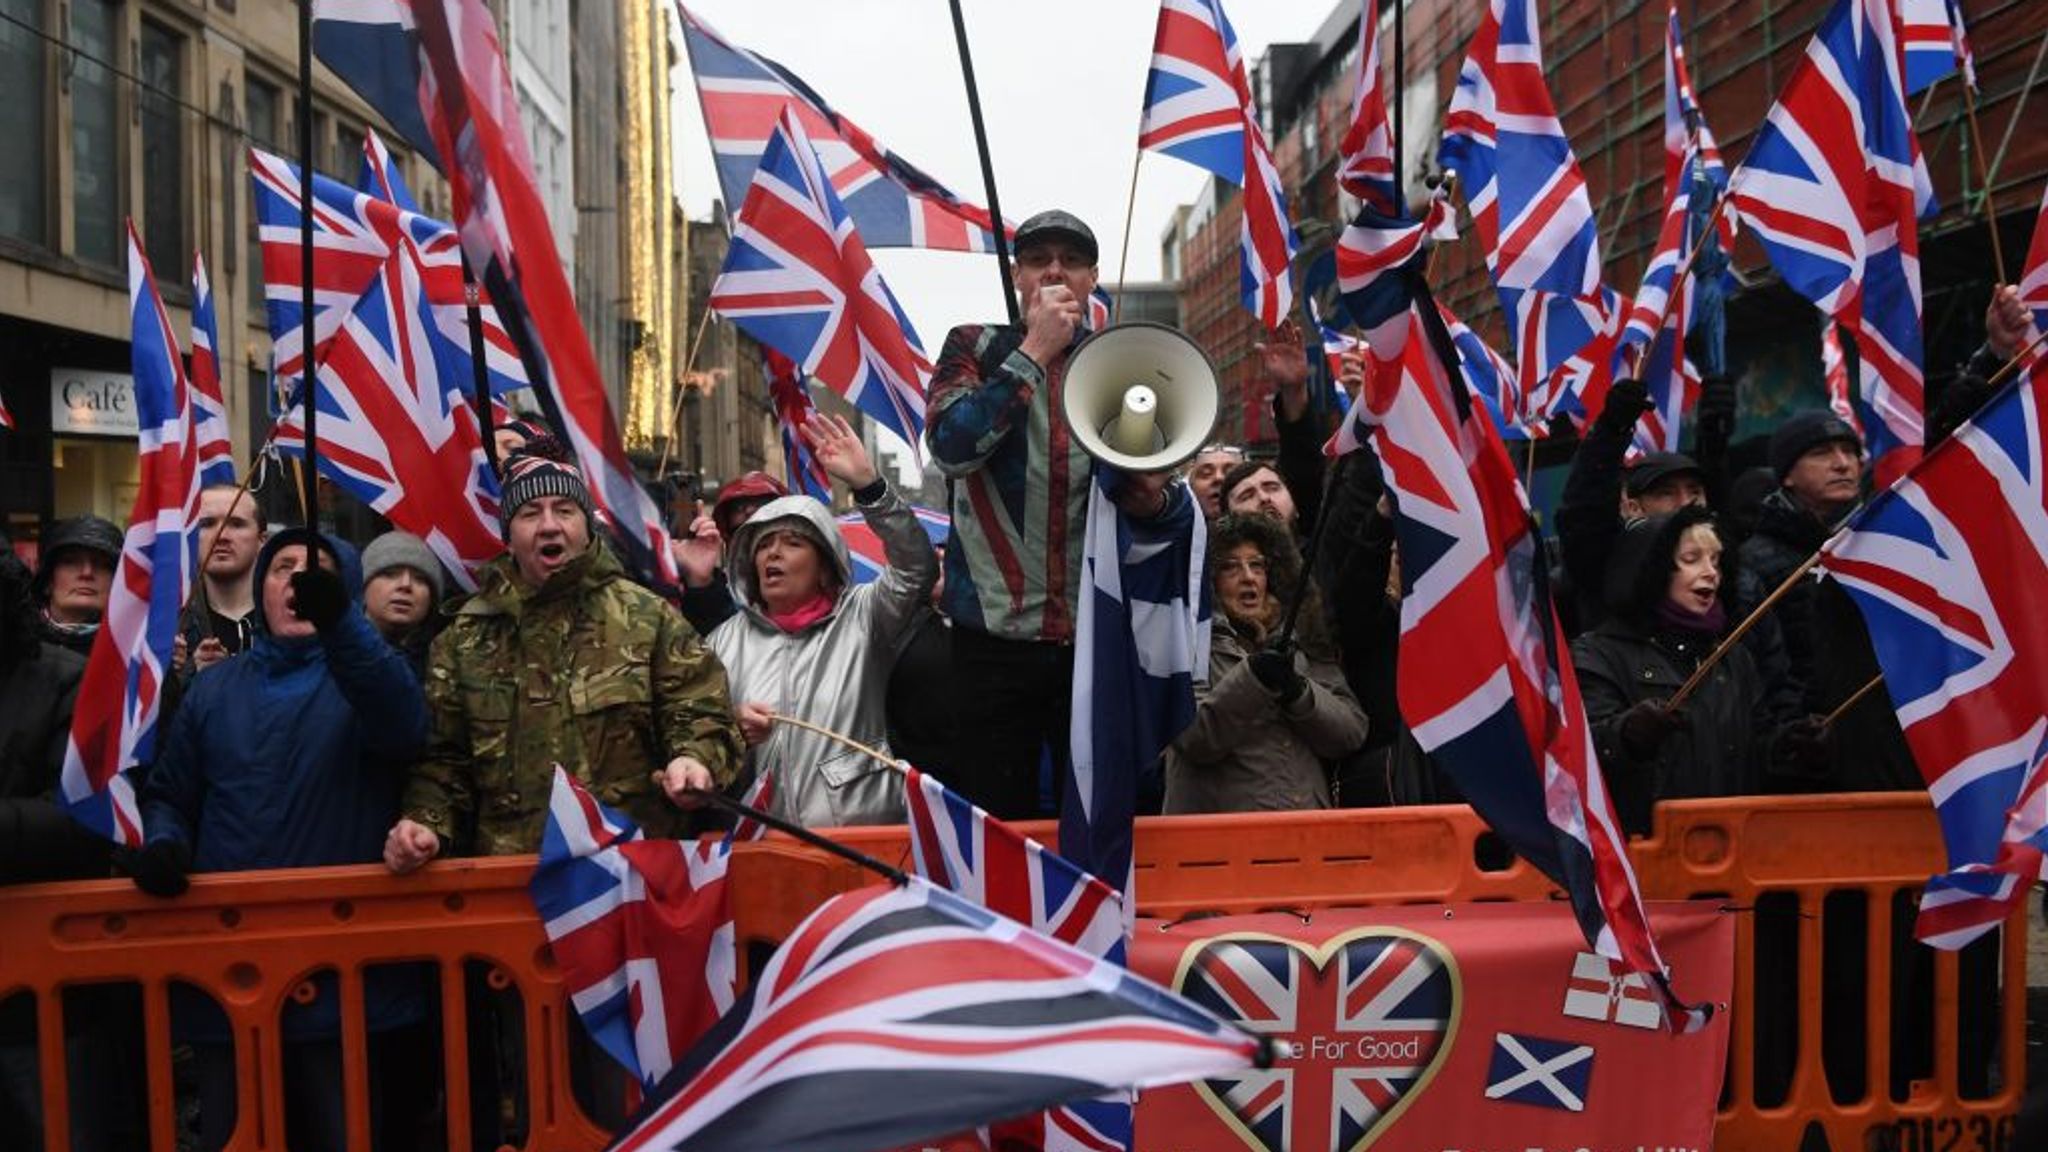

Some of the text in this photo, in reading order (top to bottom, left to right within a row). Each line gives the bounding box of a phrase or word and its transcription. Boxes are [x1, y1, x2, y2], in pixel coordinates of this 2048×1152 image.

[63, 380, 126, 413] Café
[1311, 1036, 1349, 1059] For
[1357, 1036, 1419, 1060] Good
